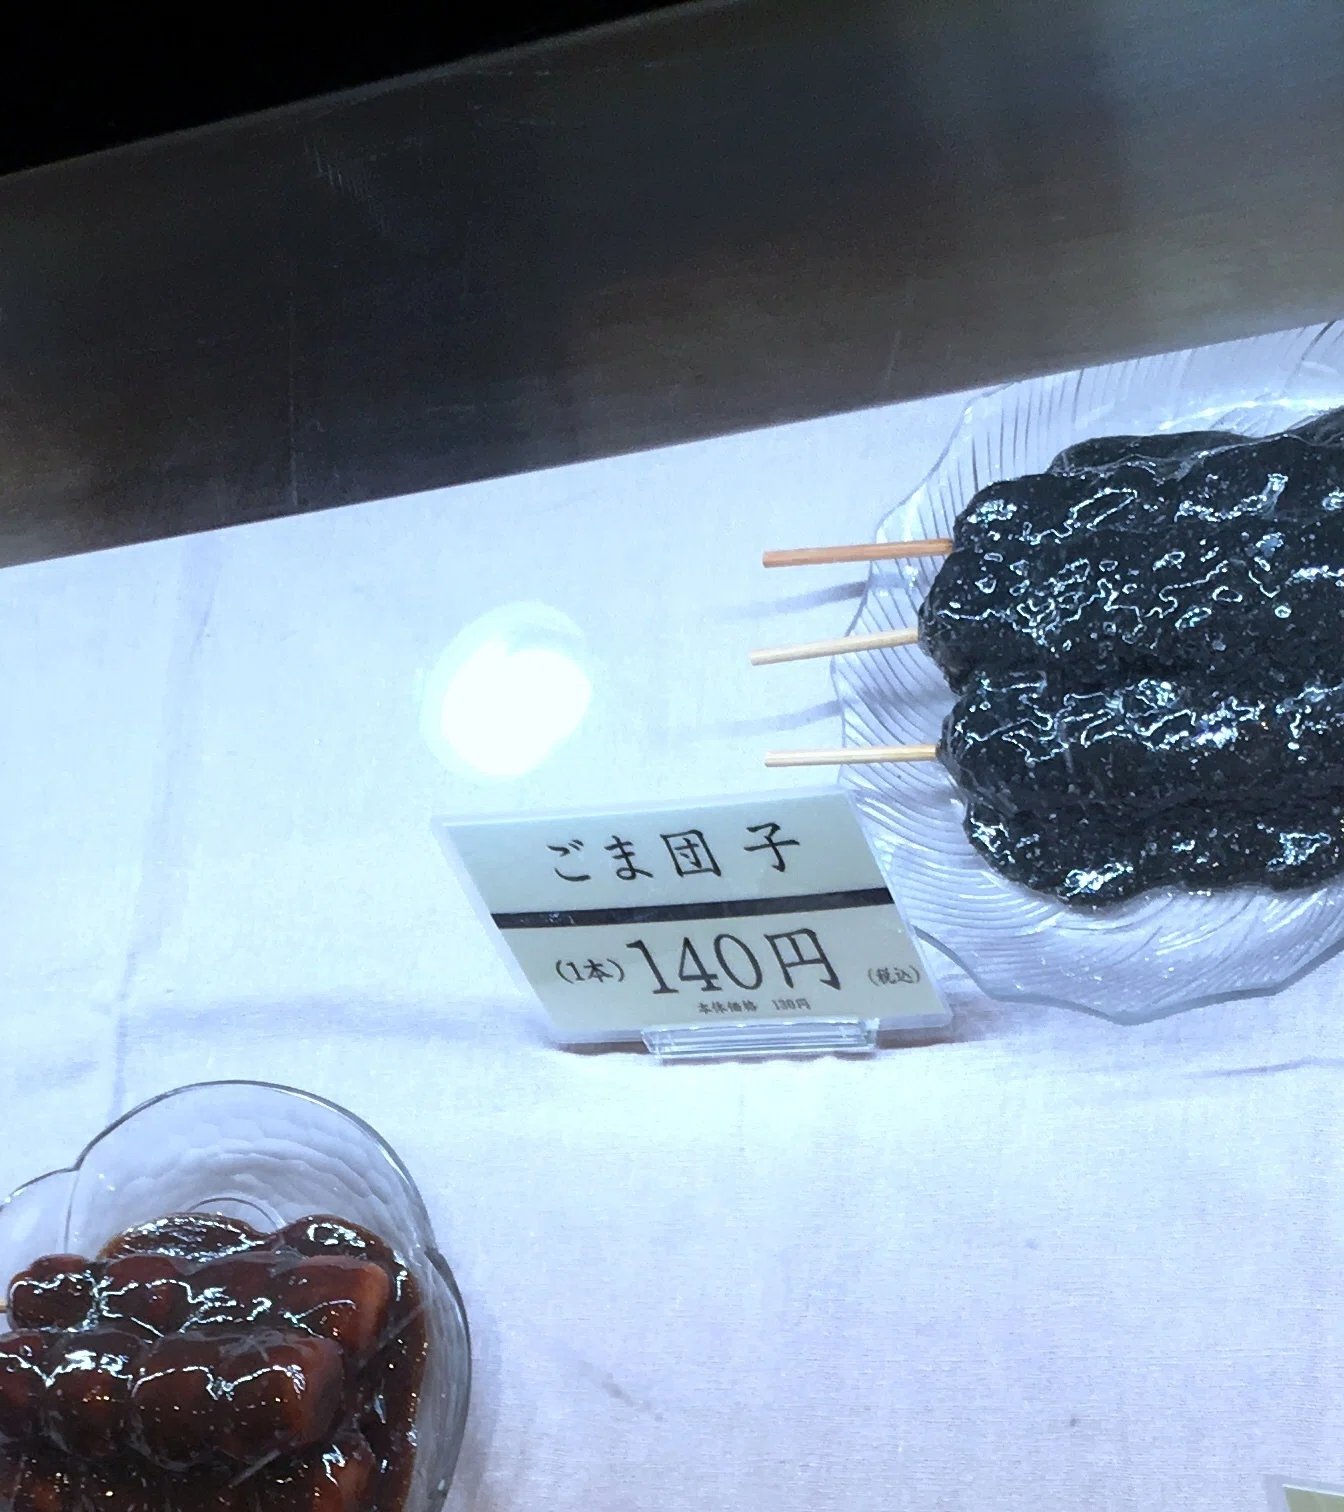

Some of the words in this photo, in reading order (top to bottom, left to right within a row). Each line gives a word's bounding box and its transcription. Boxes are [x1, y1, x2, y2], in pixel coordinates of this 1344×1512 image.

[548, 821, 801, 882] ごま団子
[626, 927, 843, 994] 140円
